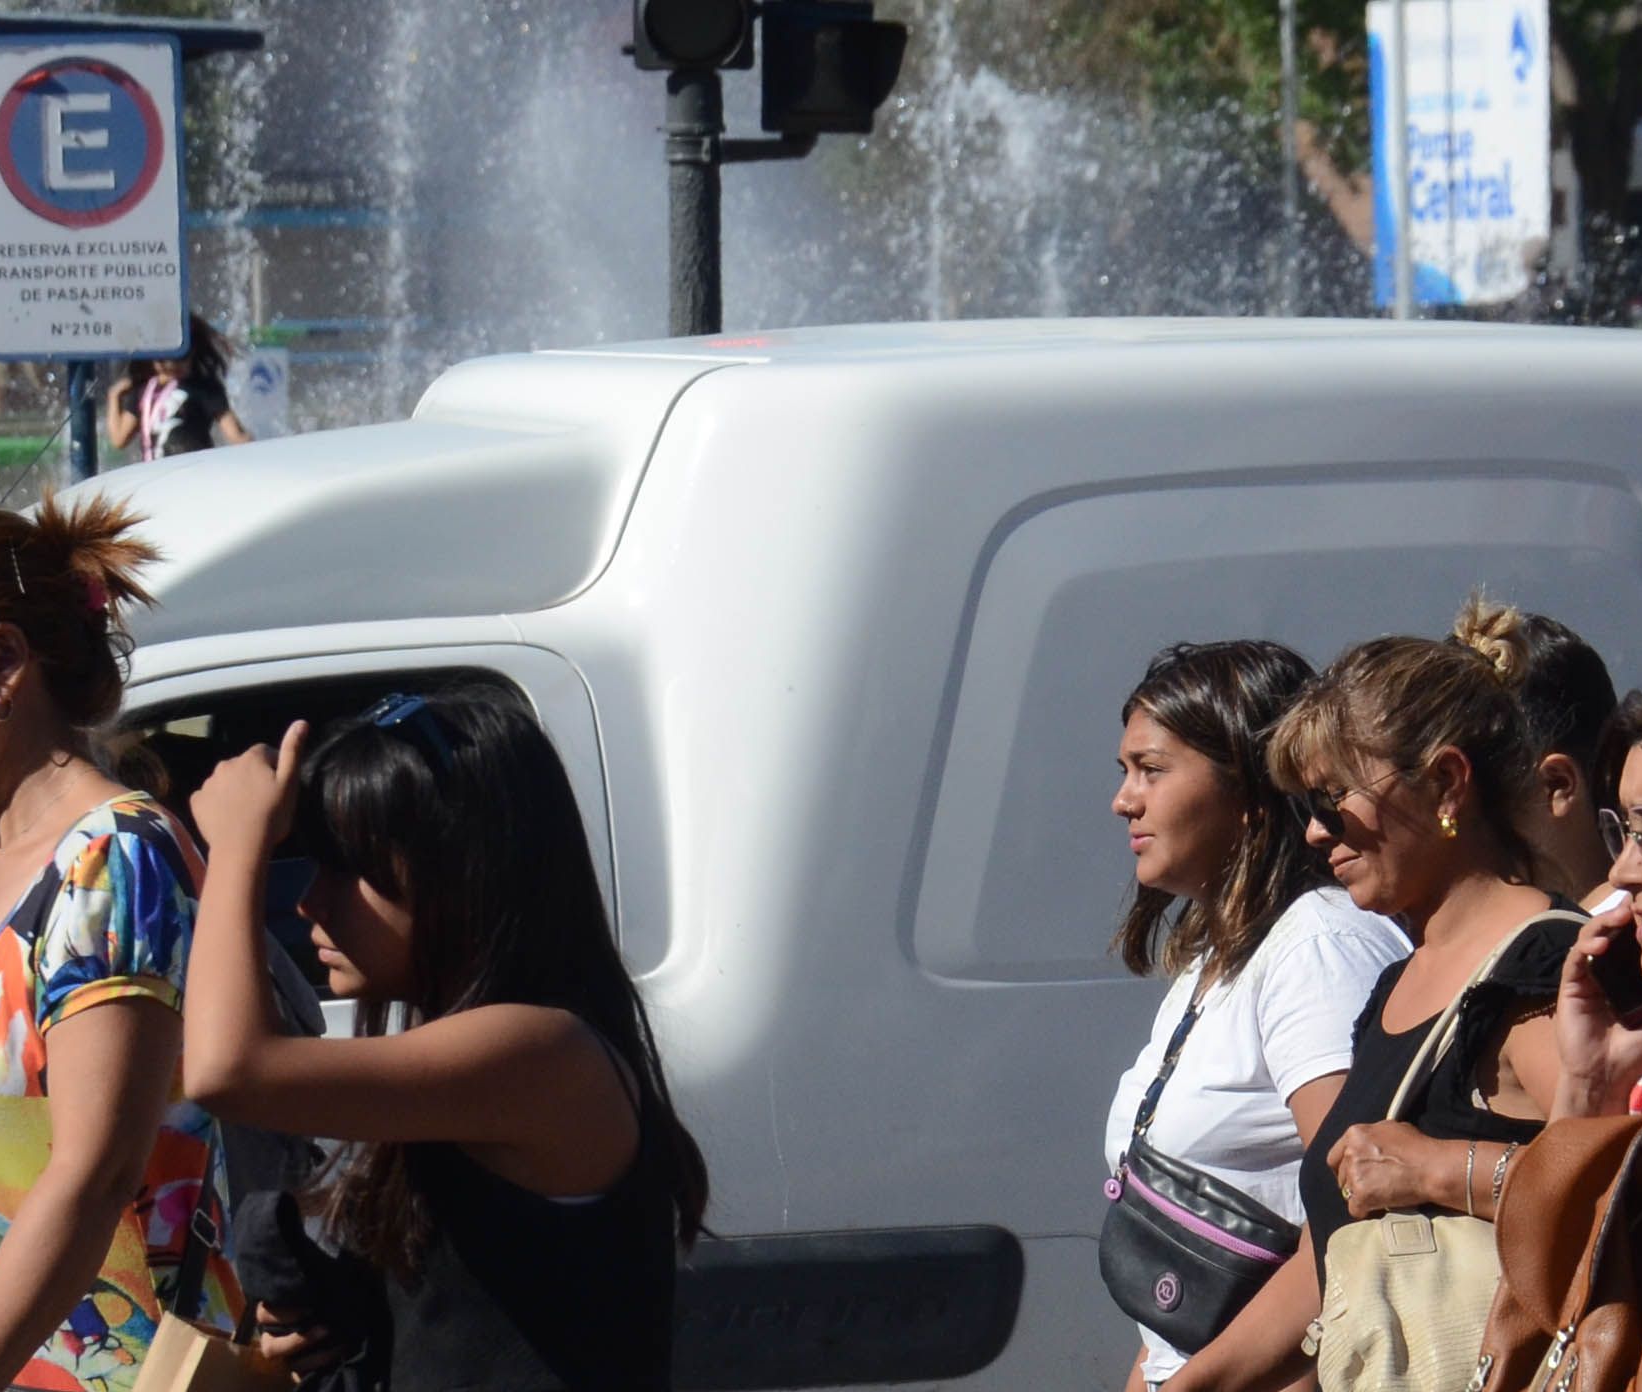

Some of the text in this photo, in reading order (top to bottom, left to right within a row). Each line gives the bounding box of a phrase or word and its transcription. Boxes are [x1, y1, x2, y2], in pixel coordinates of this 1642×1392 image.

[41, 91, 116, 192] E
[1409, 160, 1515, 223] Central
[76, 240, 168, 256] EXCLUSIVA
[104, 260, 177, 278] PÚBLICO
[20, 286, 145, 303] DE PASAJEROS
